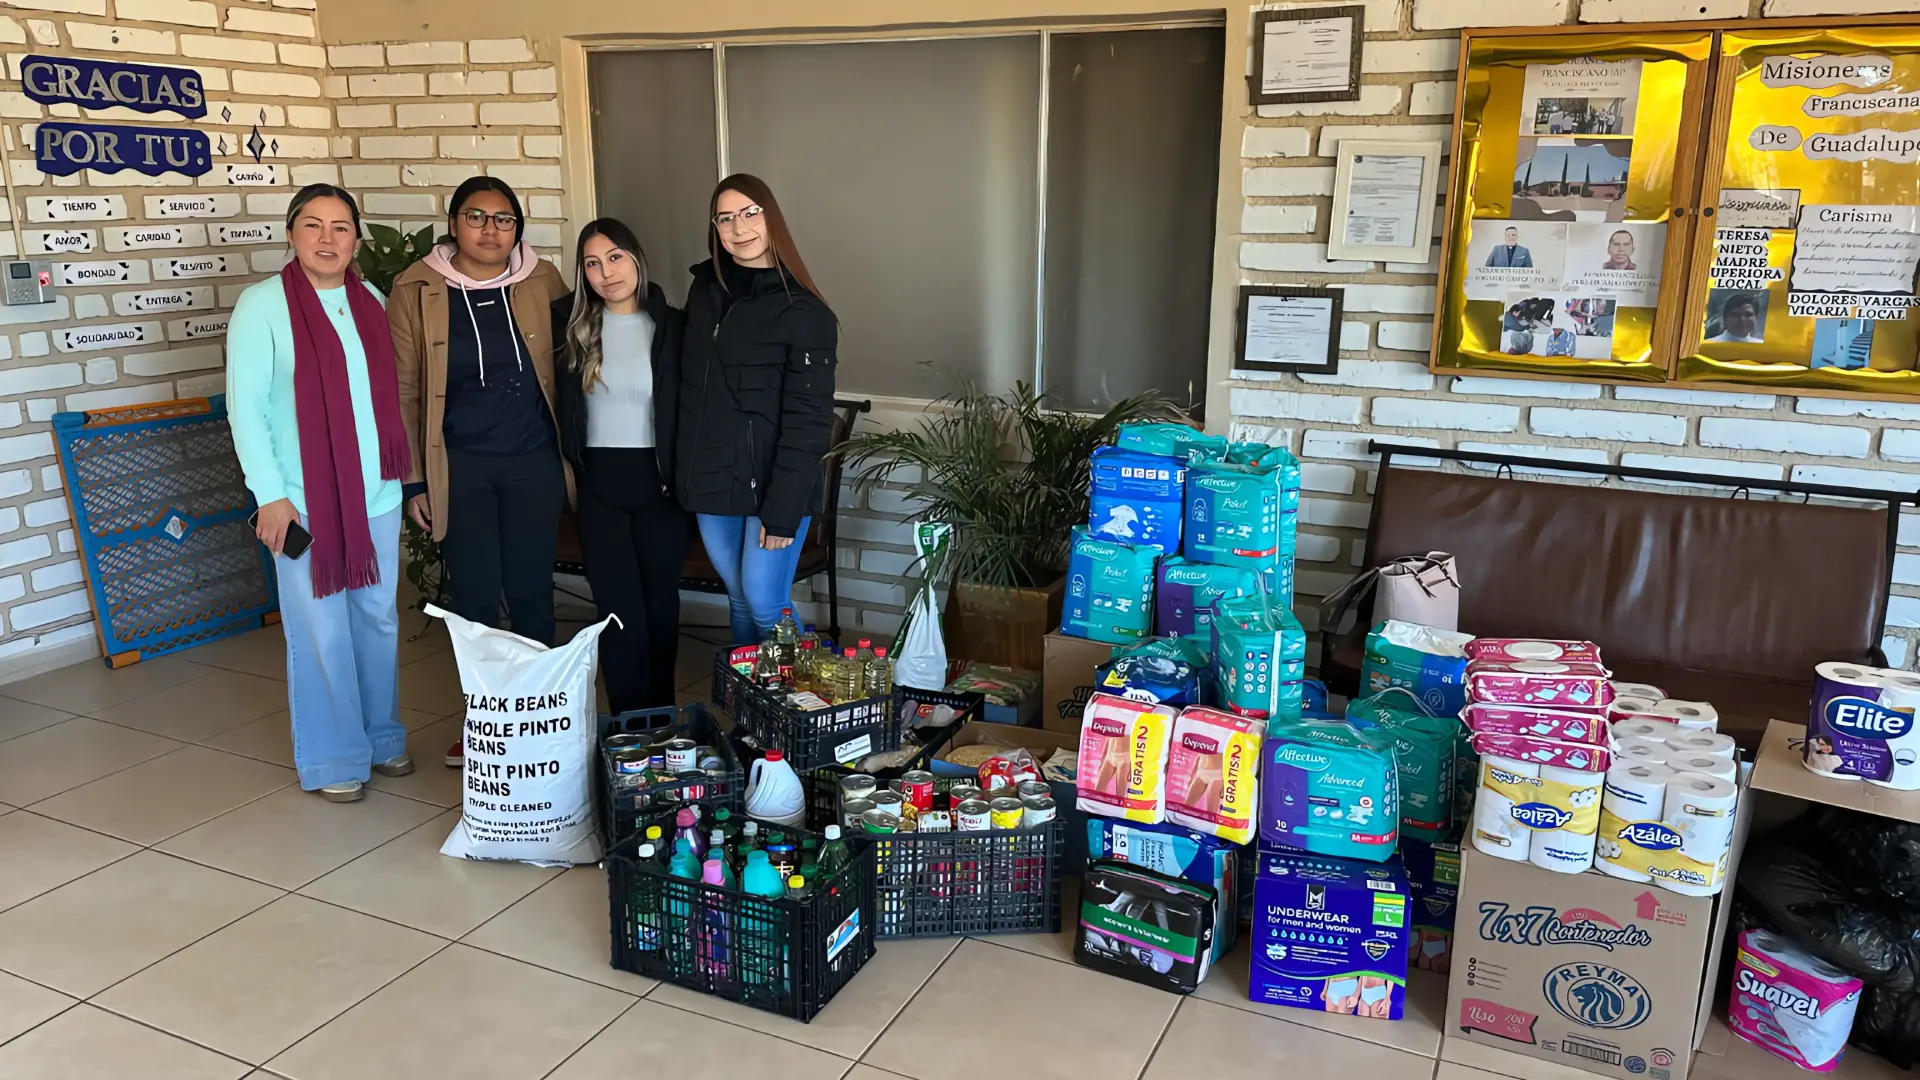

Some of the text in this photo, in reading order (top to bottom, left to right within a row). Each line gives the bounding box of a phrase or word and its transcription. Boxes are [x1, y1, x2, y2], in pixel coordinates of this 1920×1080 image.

[24, 62, 202, 108] GRACIAS
[41, 128, 203, 167] POR TU:
[1760, 131, 1787, 146] De
[1820, 208, 1892, 223] Carisma
[1718, 230, 1769, 241] TERESA
[1716, 257, 1767, 268] MADRE
[1717, 279, 1762, 289] LOCAL
[1789, 294, 1920, 308] DOLORES VARGAS
[1791, 306, 1905, 320] VICARIA LOCAL
[515, 692, 568, 712] BEANS
[467, 717, 571, 738] WHOLE PINTO
[1093, 722, 1123, 734] Depend
[1835, 703, 1905, 734] Elite
[468, 734, 507, 756] BEANS
[1184, 736, 1217, 752] Depend
[1133, 726, 1148, 785] 2 GRATIS
[1279, 748, 1327, 764] Affective
[468, 758, 560, 779] SPLIT PINTO
[468, 775, 511, 797] BEANS
[1225, 760, 1240, 803] GRATIS
[1318, 772, 1366, 788] Advanced
[500, 801, 552, 812] CLEANED
[1276, 820, 1287, 828] 10
[1511, 806, 1573, 827] Azálea
[1617, 824, 1683, 848] Azálea
[1267, 905, 1350, 924] UNDERWEAR
[1267, 915, 1361, 934] for men and women
[1479, 901, 1556, 946] 7x7
[1543, 917, 1652, 951] Contenedor
[1558, 964, 1640, 997] REYMA
[1735, 969, 1819, 1019] Suavel
